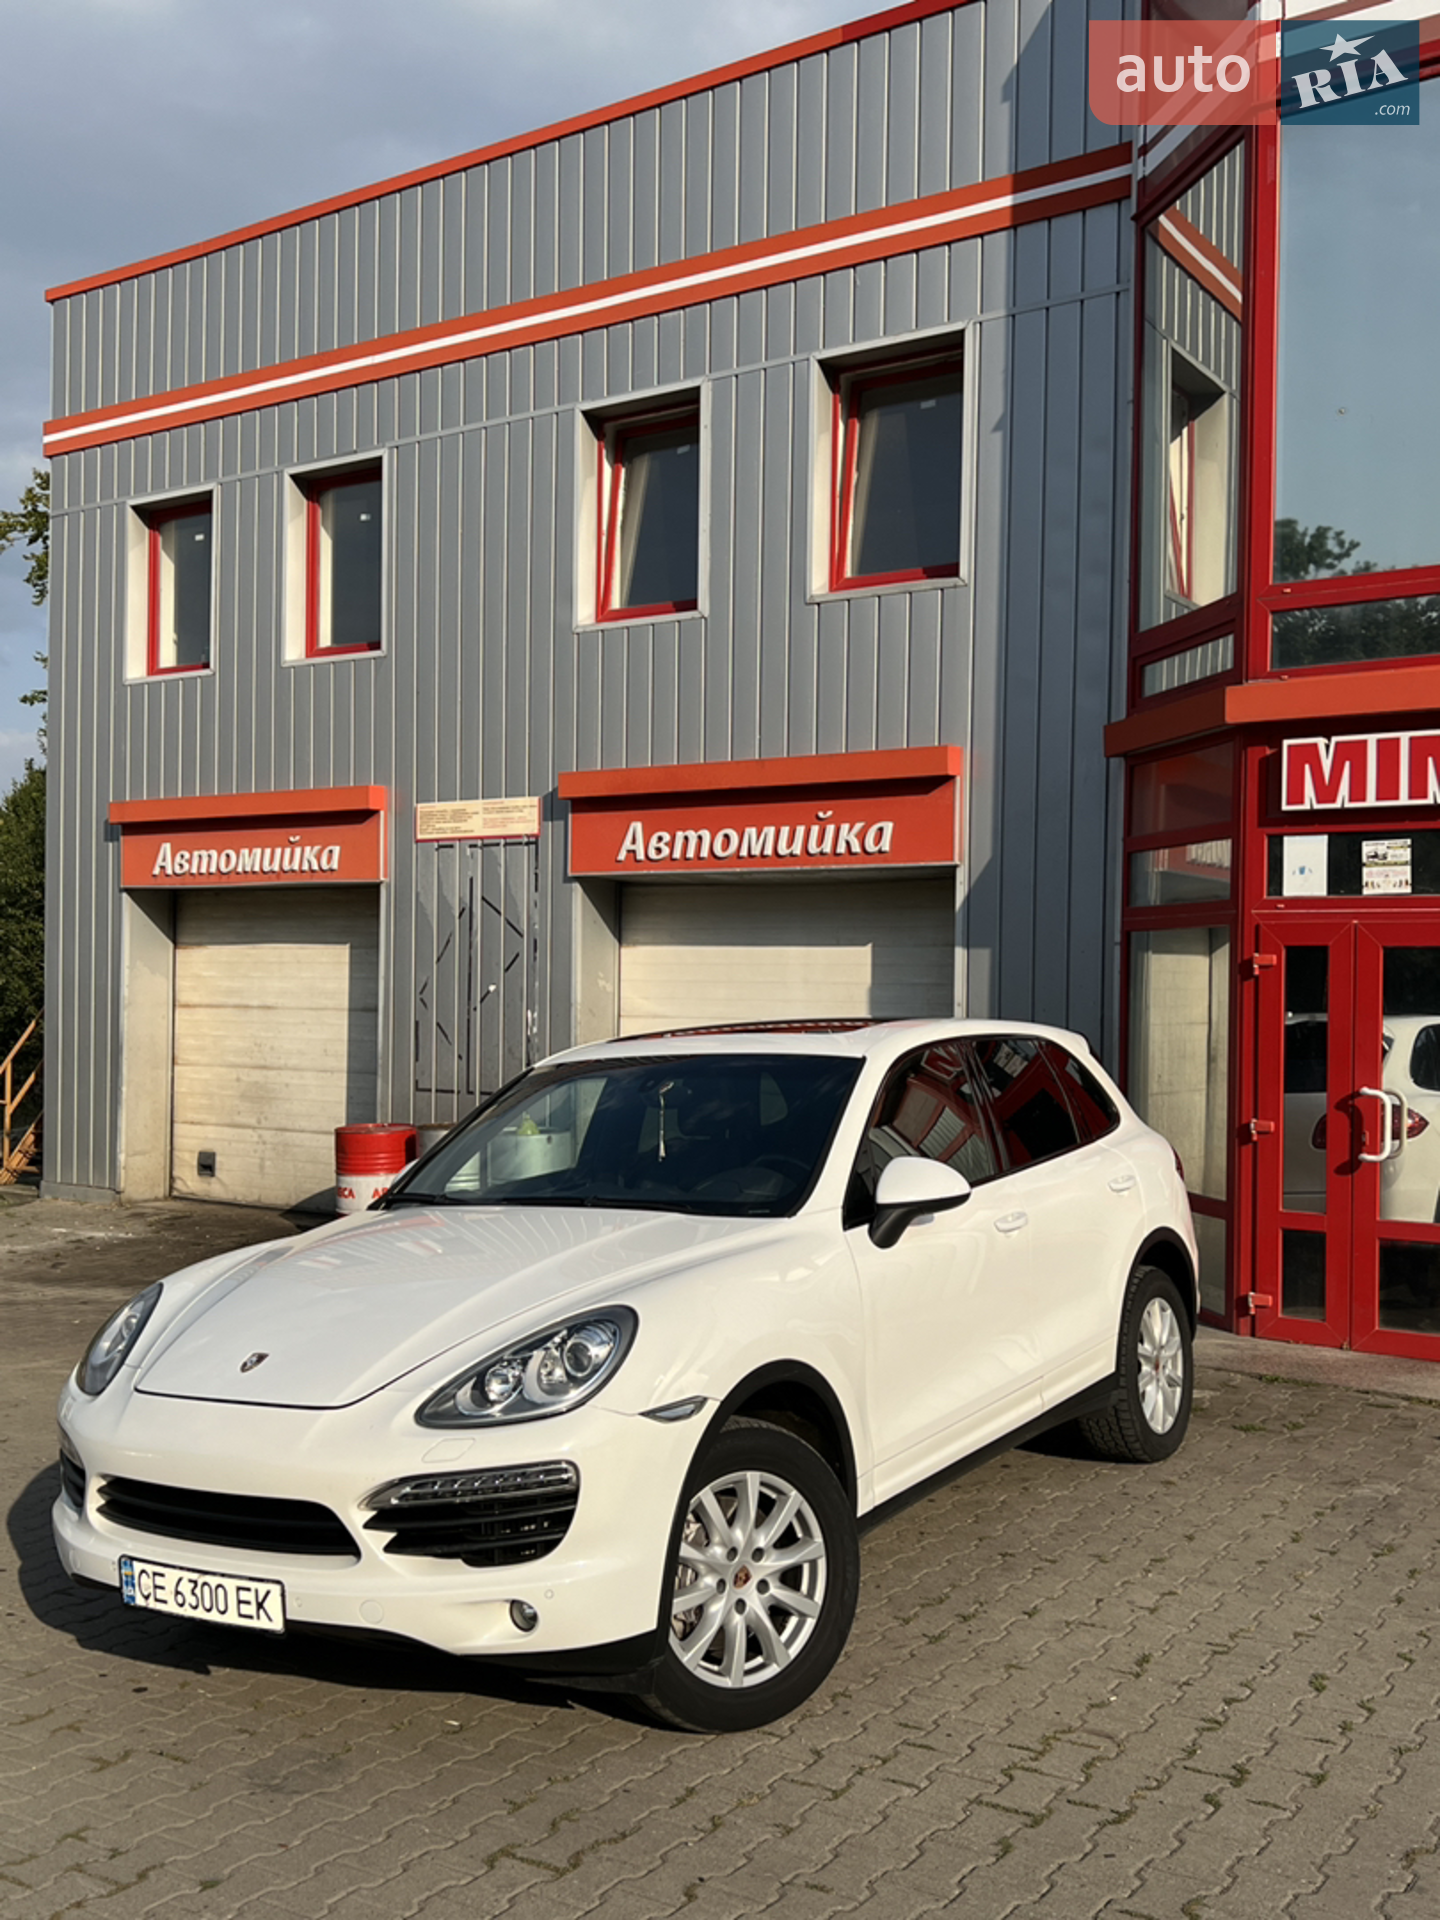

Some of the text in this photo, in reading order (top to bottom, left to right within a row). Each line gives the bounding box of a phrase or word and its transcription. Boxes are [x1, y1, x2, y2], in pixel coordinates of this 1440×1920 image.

[152, 836, 340, 876] Автомийка
[616, 811, 894, 862] Автомийка
[138, 1569, 273, 1622] CE 6300 EK
